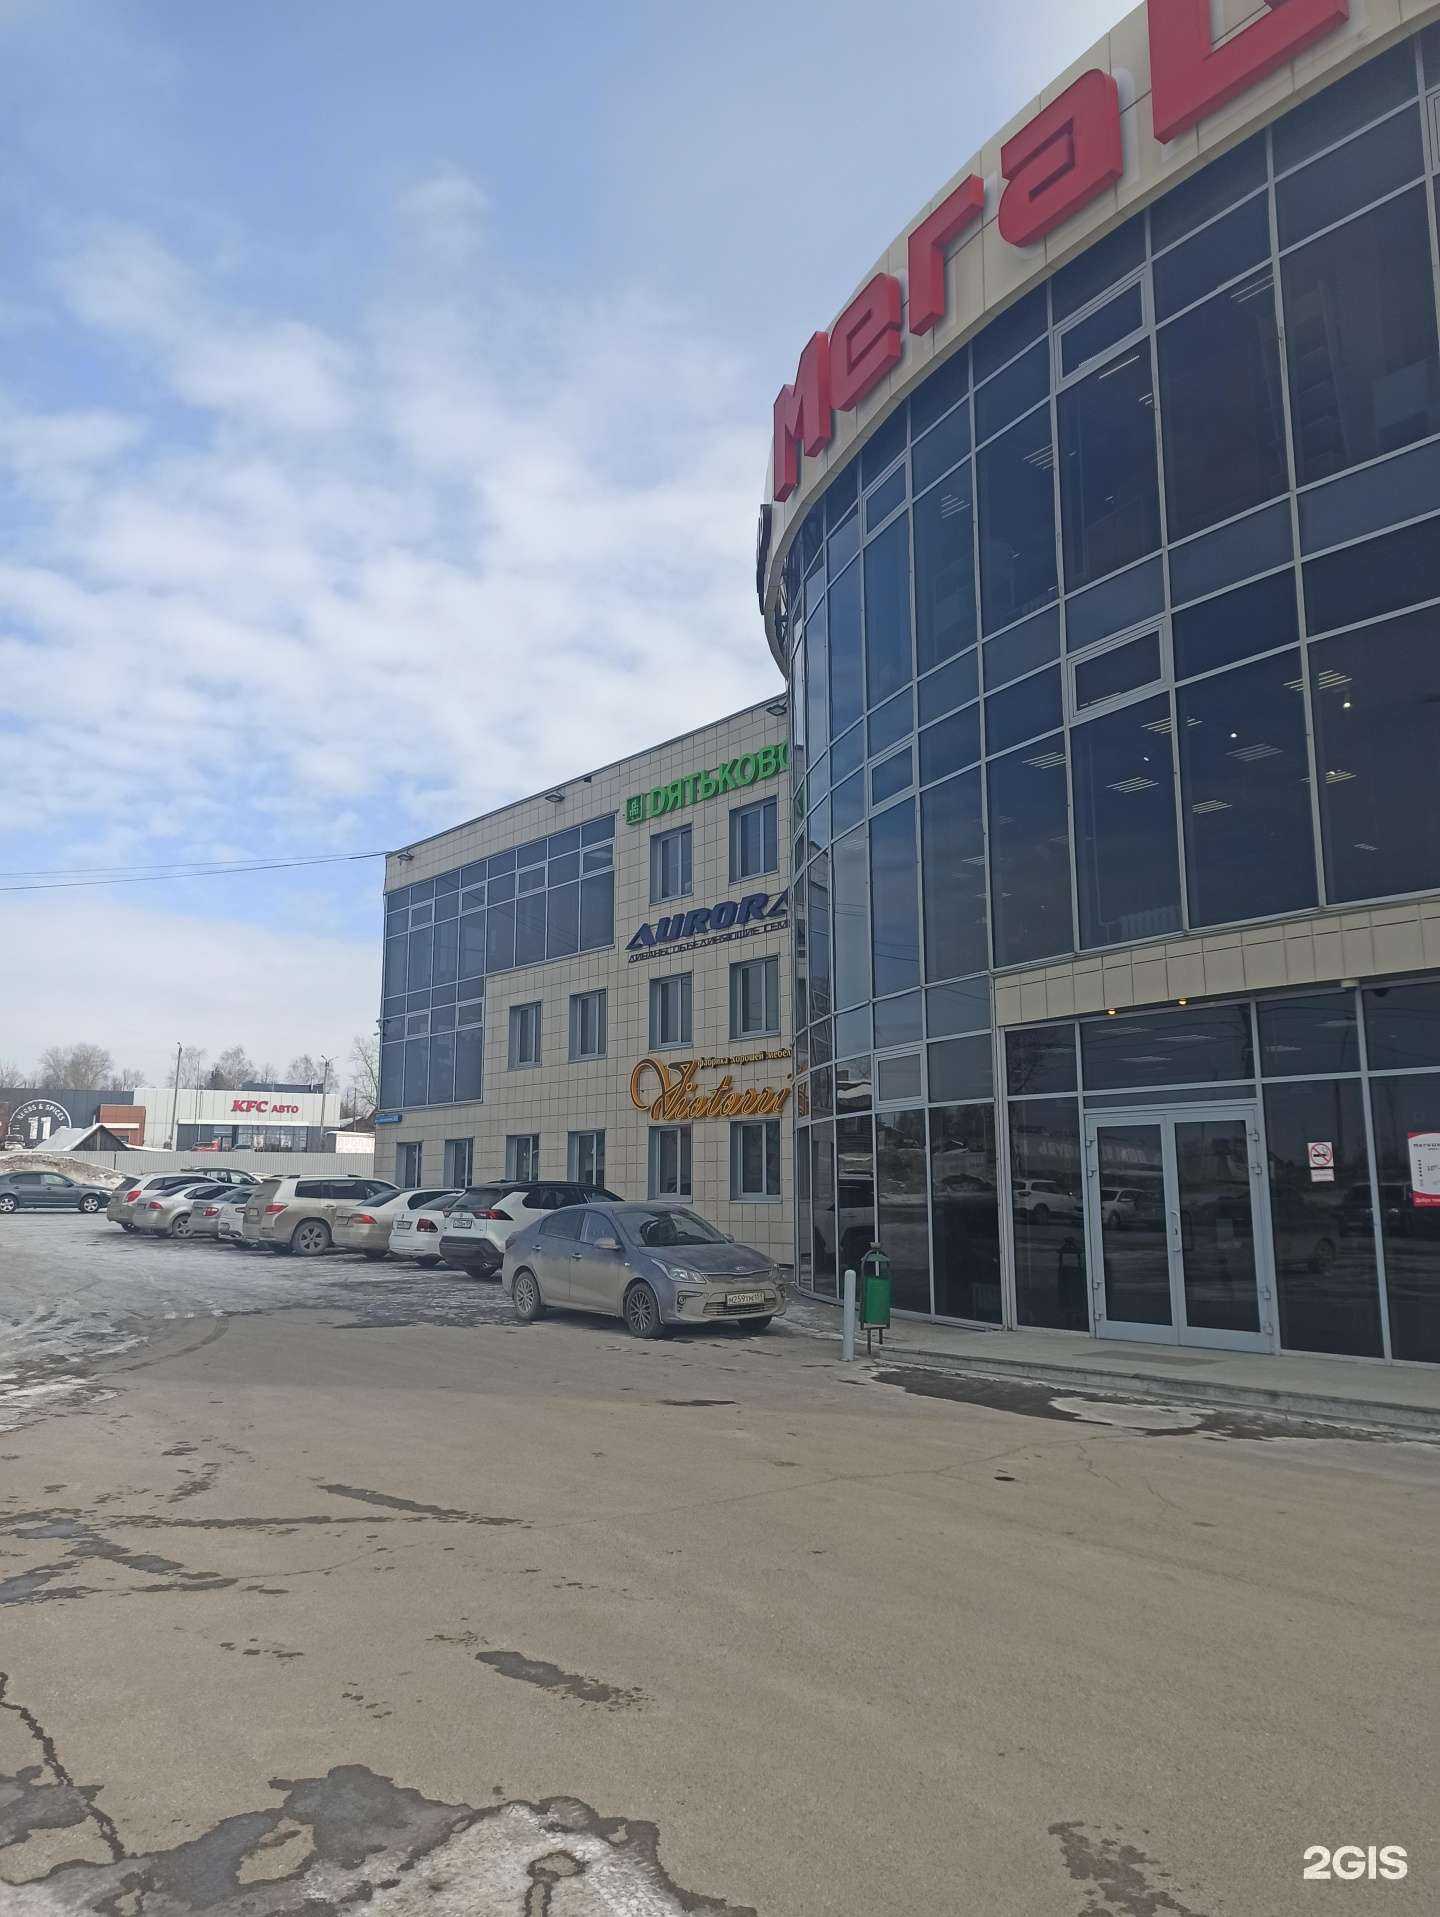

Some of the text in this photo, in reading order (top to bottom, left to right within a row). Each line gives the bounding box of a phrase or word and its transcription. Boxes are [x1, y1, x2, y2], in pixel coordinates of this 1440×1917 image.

[231, 1099, 299, 1114] KFC АВТО
[28, 1116, 51, 1139] 11
